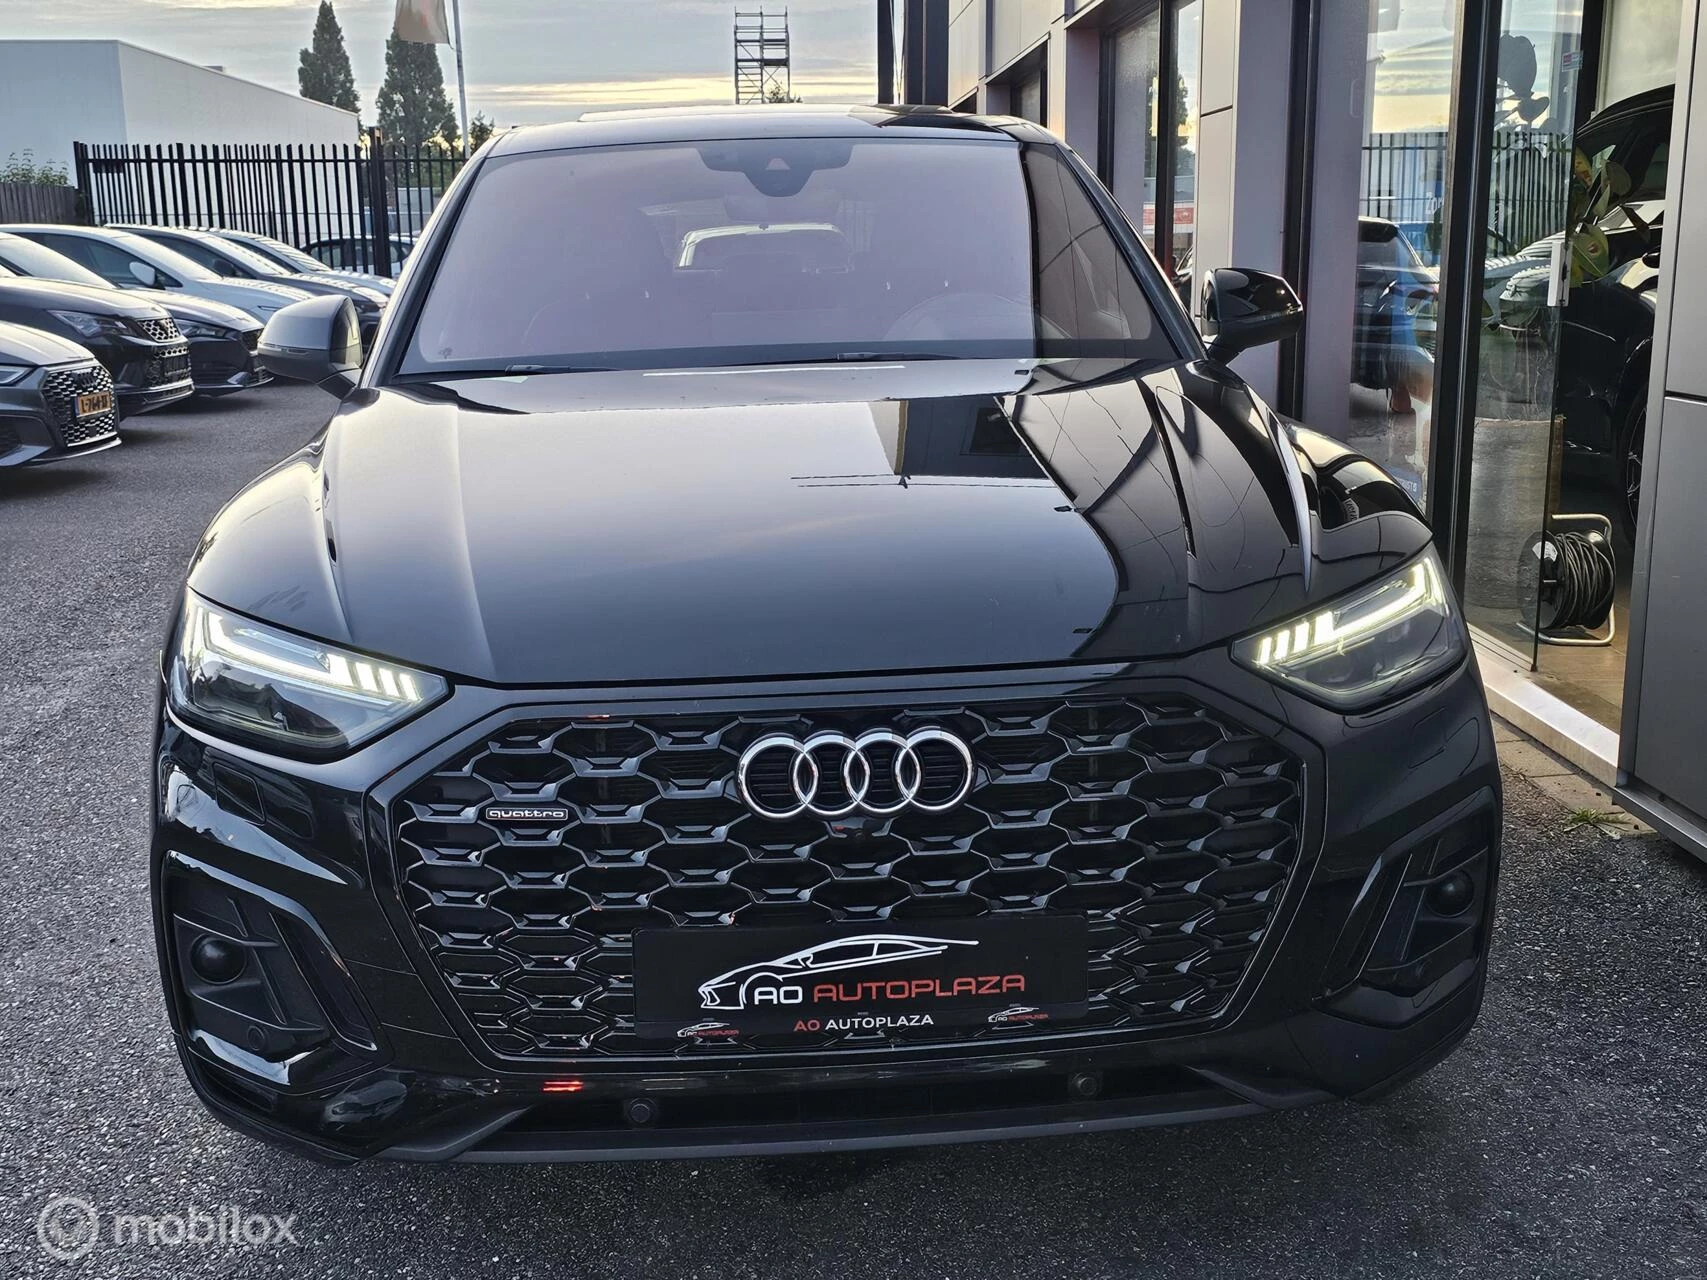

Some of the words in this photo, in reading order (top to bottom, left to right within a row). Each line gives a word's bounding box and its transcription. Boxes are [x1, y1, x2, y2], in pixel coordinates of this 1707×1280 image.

[489, 809, 564, 819] quattro
[754, 985, 803, 1005] AO
[812, 974, 1026, 1003] AUTOPLAZA
[793, 1018, 822, 1032] AO
[824, 1014, 935, 1031] AUTOPLAZA
